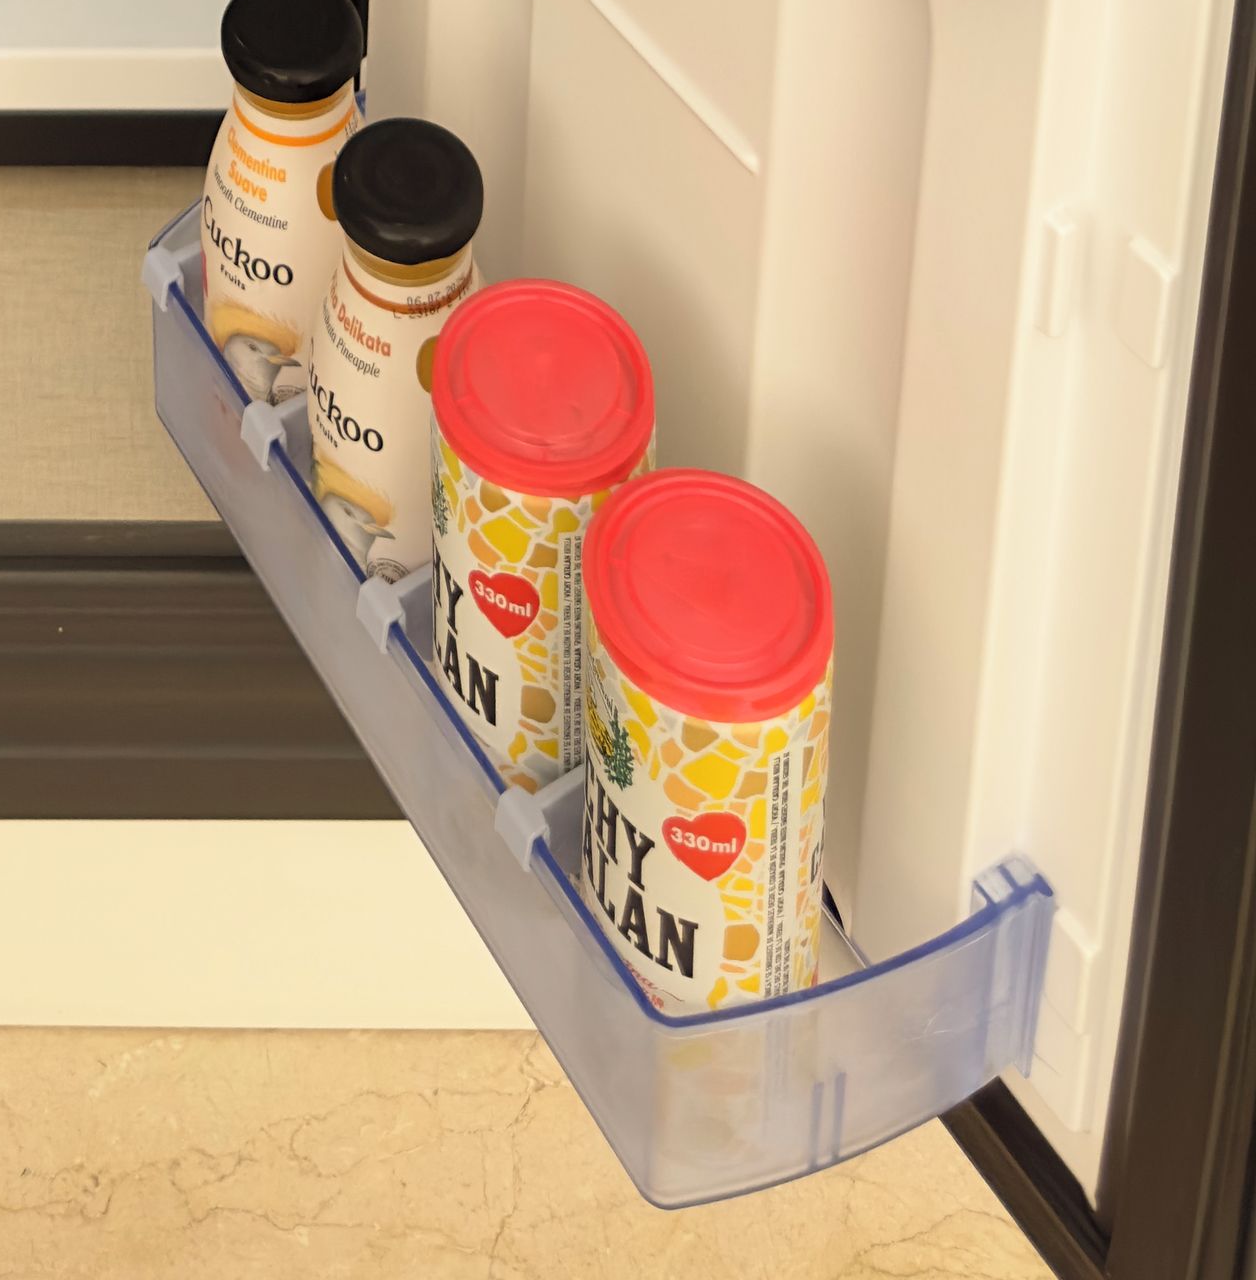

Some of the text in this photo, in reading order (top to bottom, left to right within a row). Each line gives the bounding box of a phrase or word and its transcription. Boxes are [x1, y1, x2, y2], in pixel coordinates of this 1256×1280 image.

[226, 124, 288, 184] Clementina
[227, 161, 268, 203] Suave
[233, 197, 289, 231] Clementine
[203, 194, 294, 287] Cuckoo
[220, 262, 247, 291] Fruits
[336, 302, 391, 357] Delikata
[336, 336, 381, 378] Pineapple
[315, 415, 338, 449] Fruits
[474, 579, 532, 619] 330ml
[669, 827, 738, 855] 330ml
